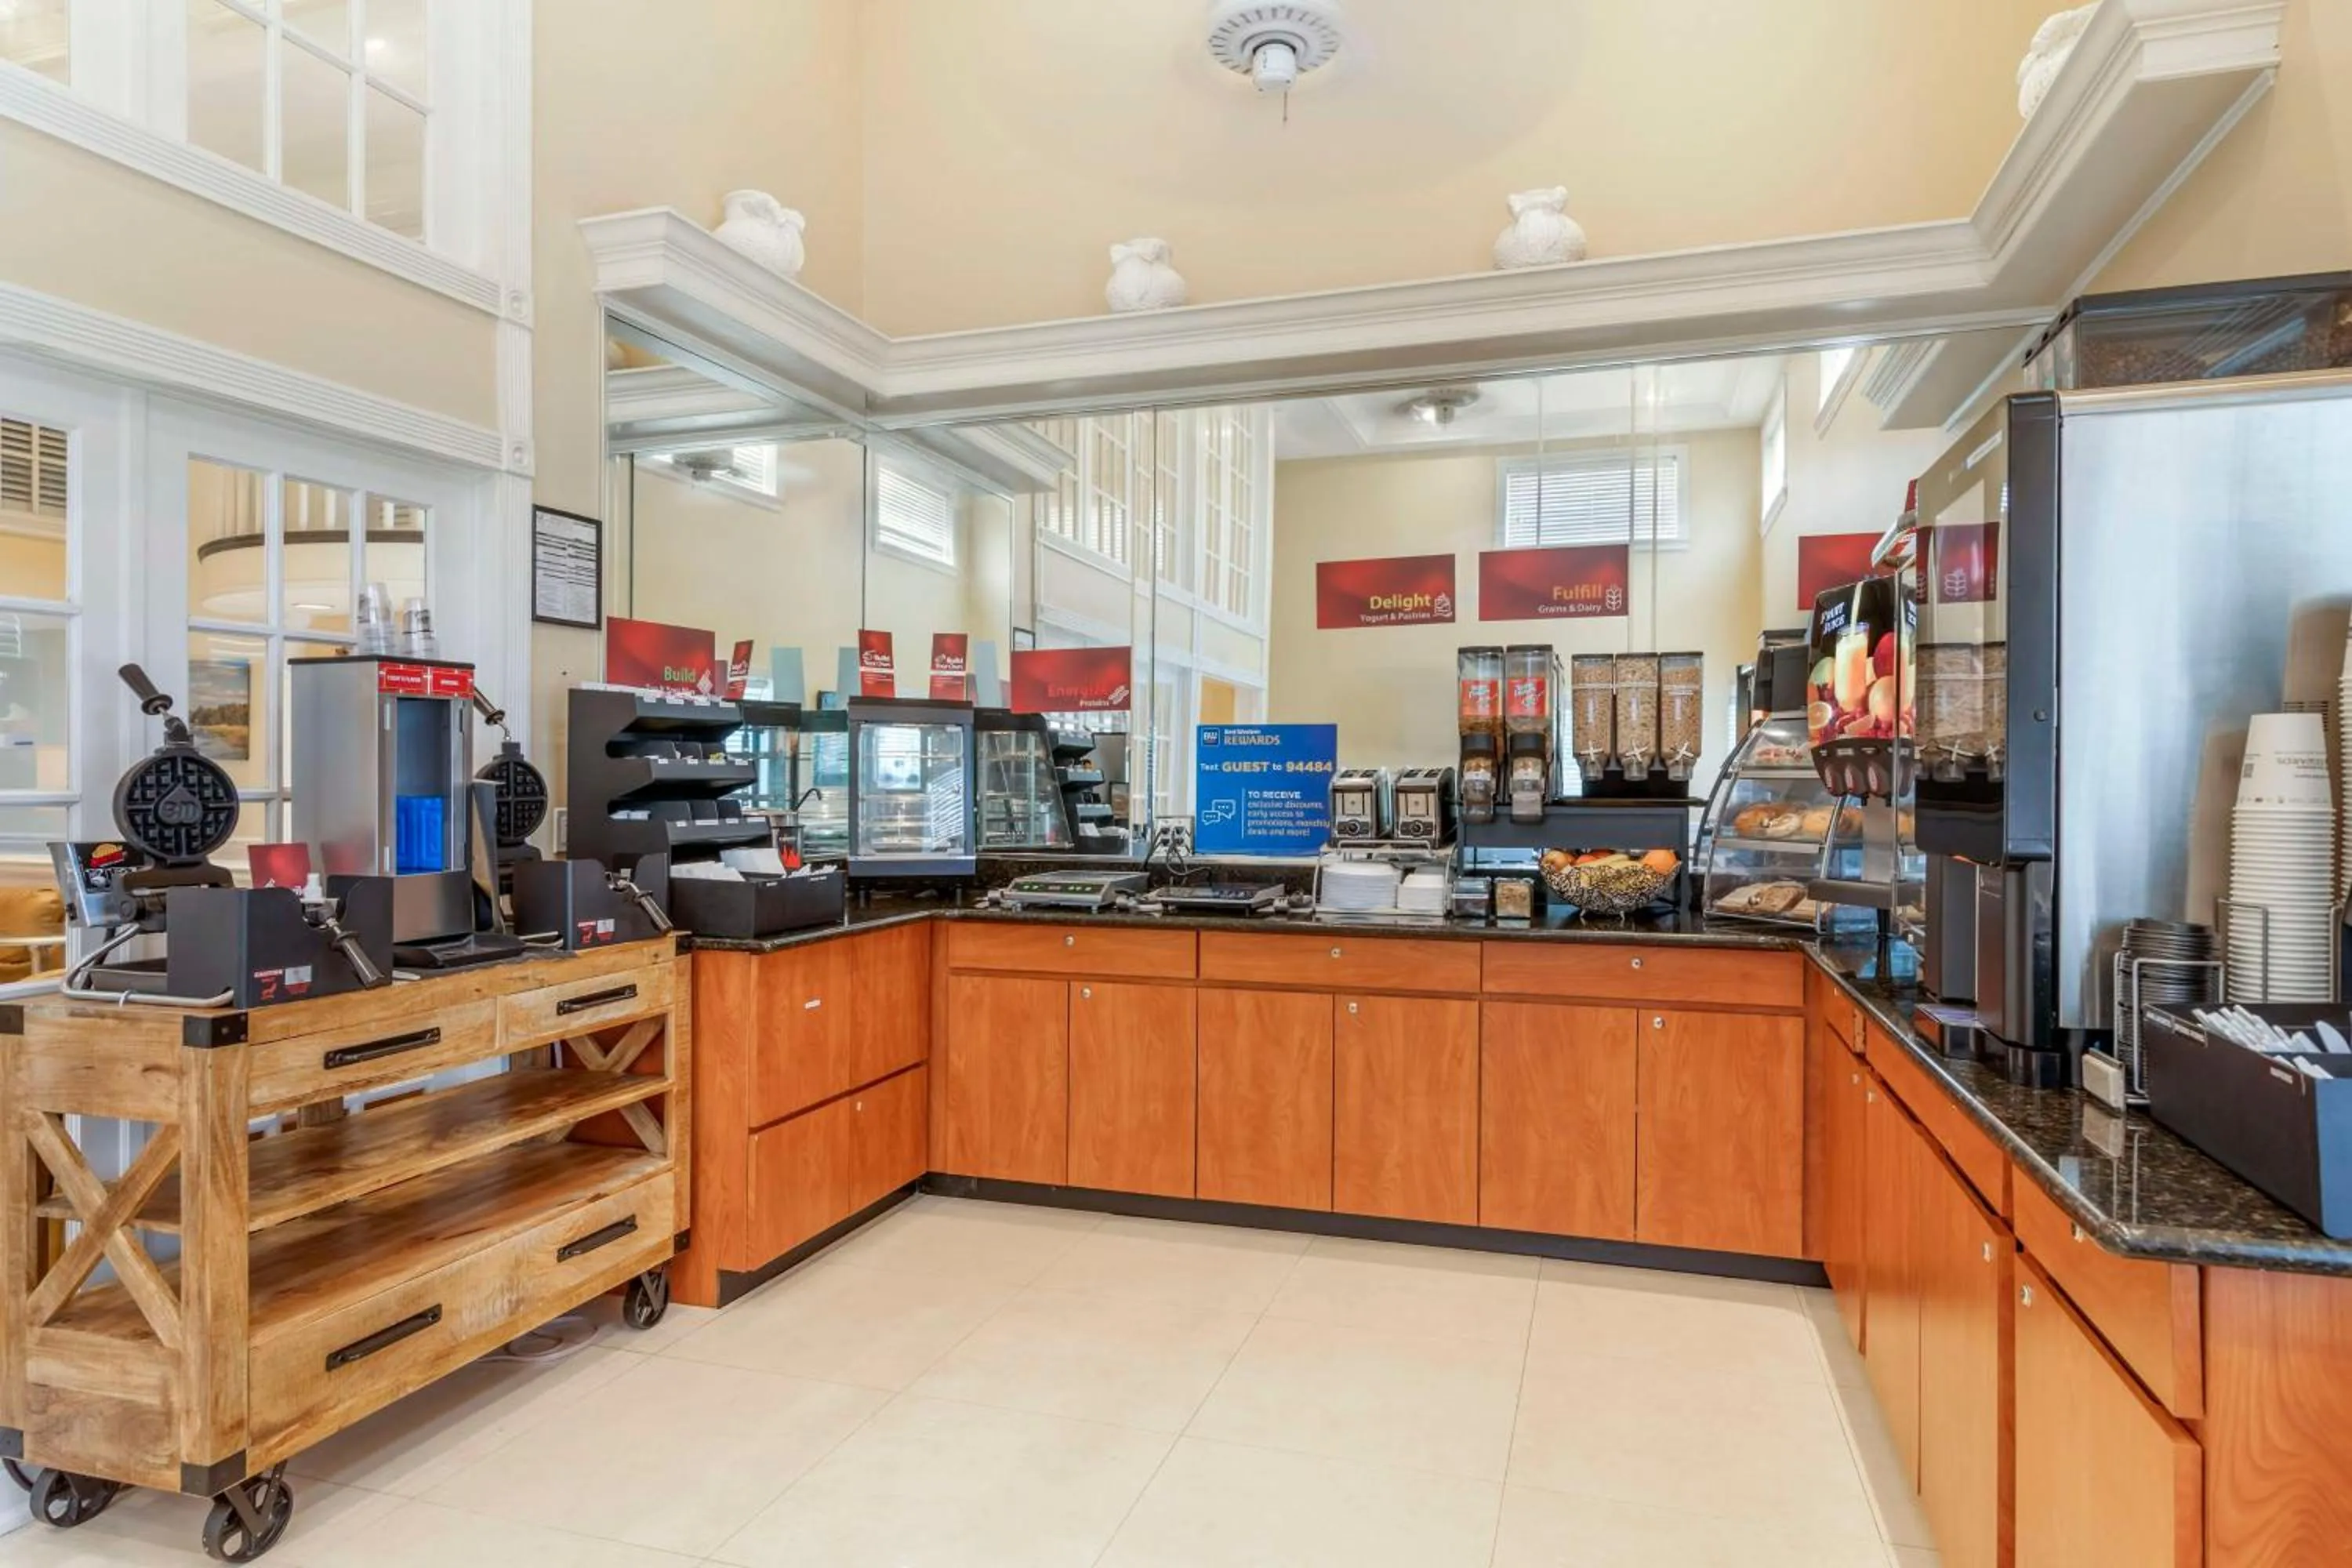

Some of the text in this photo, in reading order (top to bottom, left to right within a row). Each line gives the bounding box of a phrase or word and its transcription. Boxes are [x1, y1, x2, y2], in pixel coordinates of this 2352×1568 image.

[1553, 583, 1603, 601] Fulfill
[1370, 593, 1432, 612] Delight
[1537, 602, 1602, 614] Grains & Dairy
[1359, 614, 1388, 623] Yogurt
[1398, 612, 1431, 621] Pastries
[1820, 601, 1846, 626] FRUIT
[663, 666, 696, 683] Build
[1224, 735, 1280, 746] REWARDS
[1200, 760, 1333, 773] Text GUEST to 94484
[1247, 790, 1301, 799] TO RECEIVE
[1248, 800, 1283, 809] exclusive
[1248, 810, 1268, 819] early
